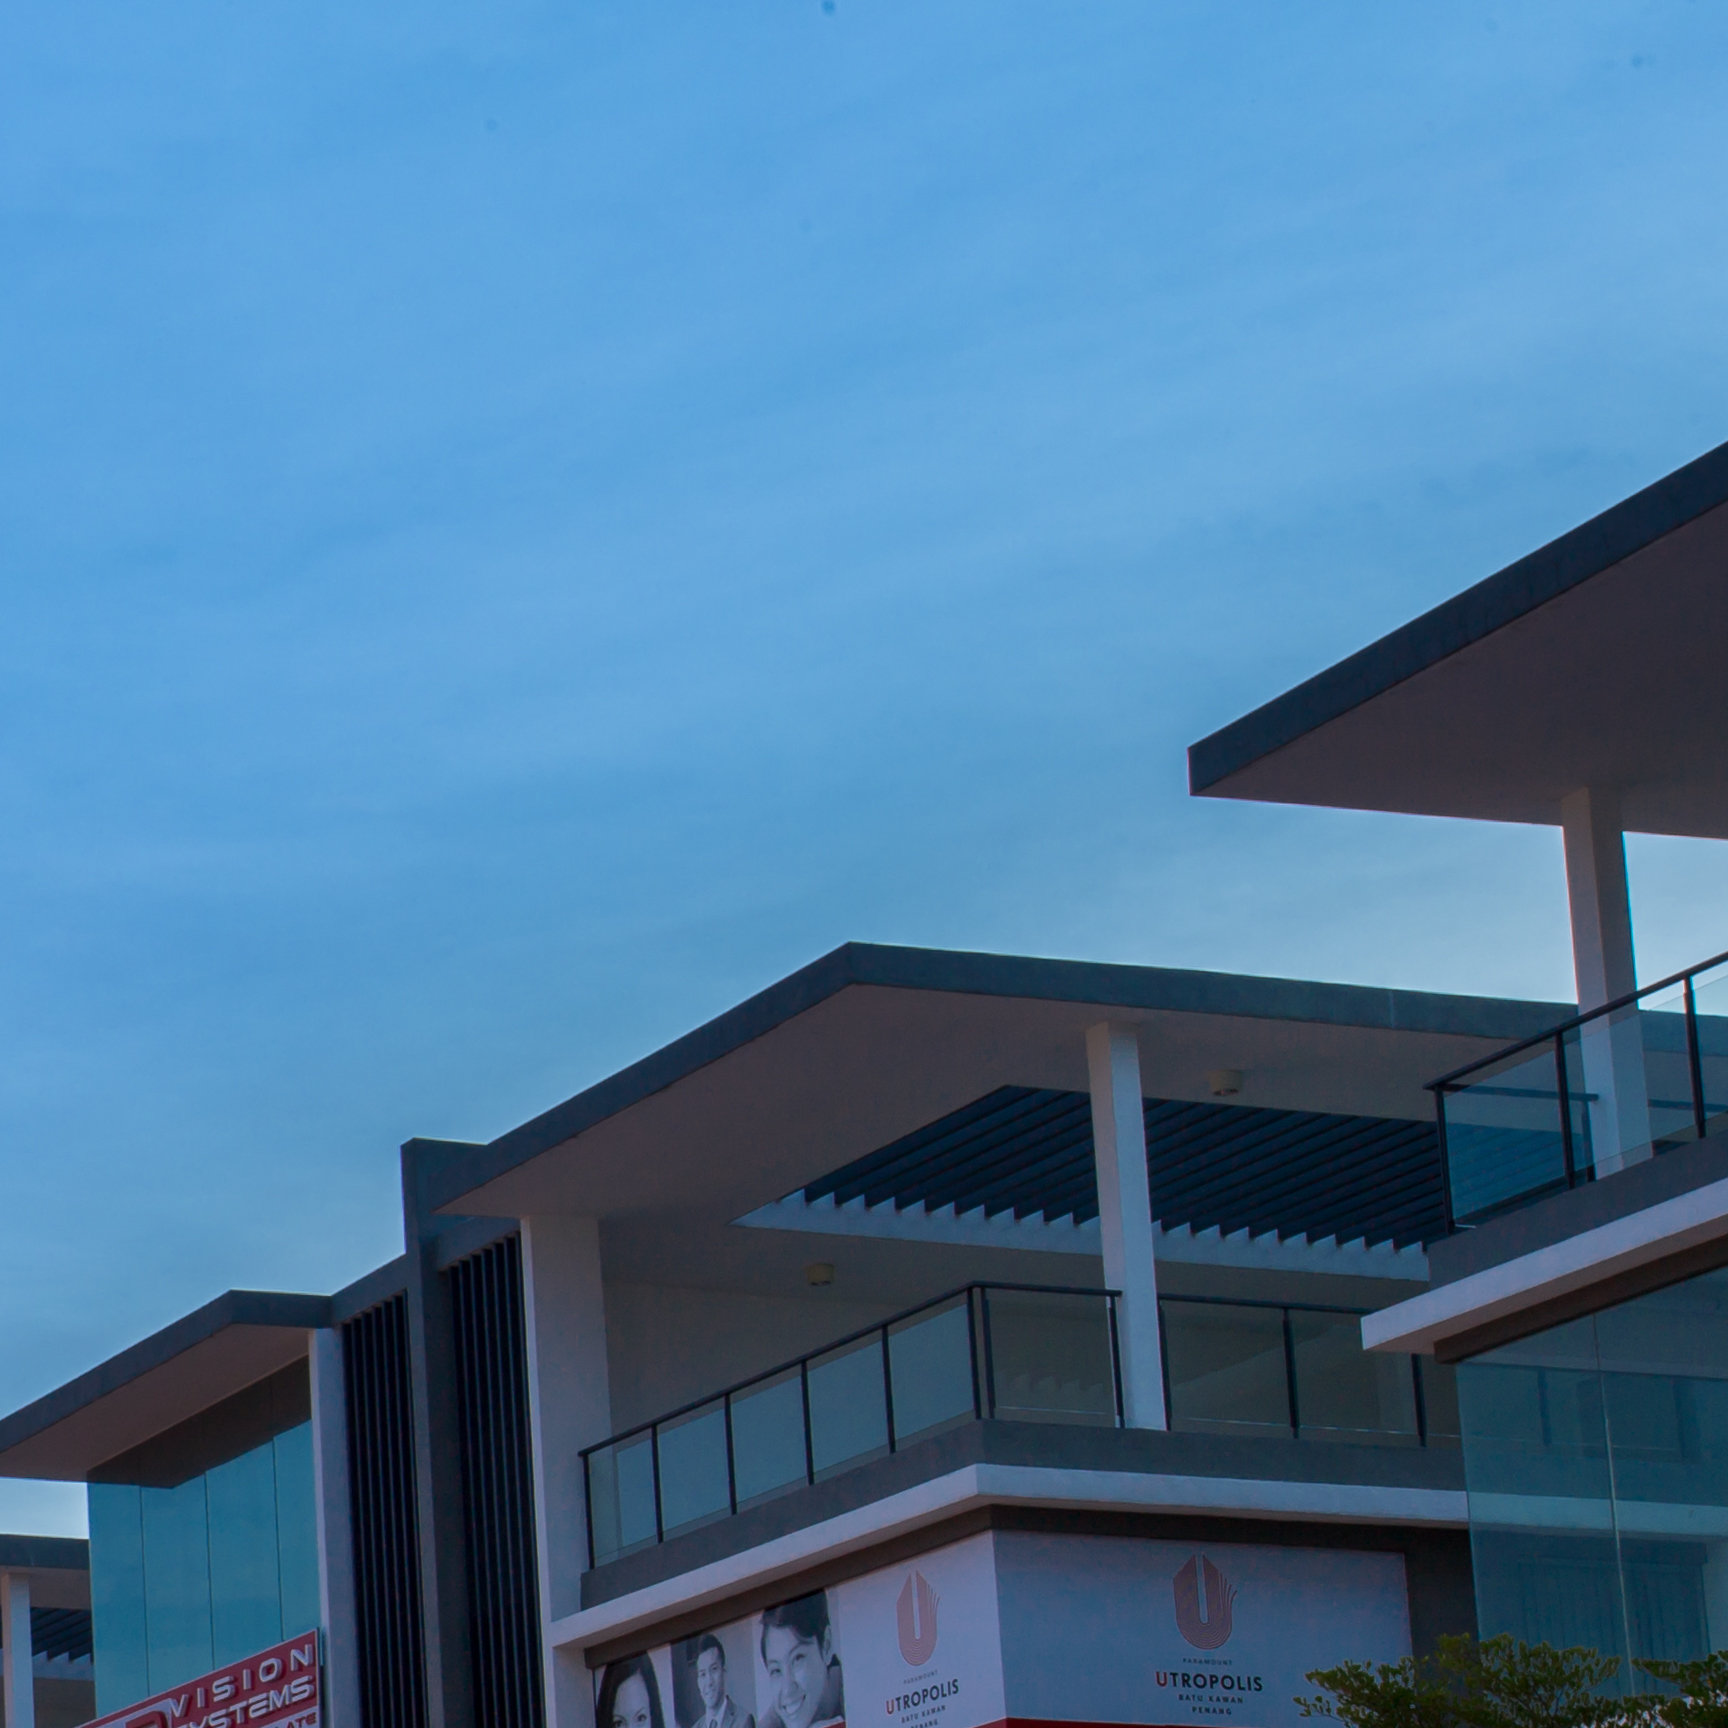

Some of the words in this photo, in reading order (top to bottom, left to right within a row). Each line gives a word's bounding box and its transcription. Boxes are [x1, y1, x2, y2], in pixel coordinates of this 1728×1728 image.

[170, 1643, 314, 1718] VISION
[1155, 1671, 1264, 1693] UTROPOLIS
[885, 1678, 960, 1715] UTROPOLIS
[1178, 1694, 1204, 1703] BATU
[1208, 1695, 1244, 1705] KAWAN
[1191, 1706, 1232, 1716] PENANG
